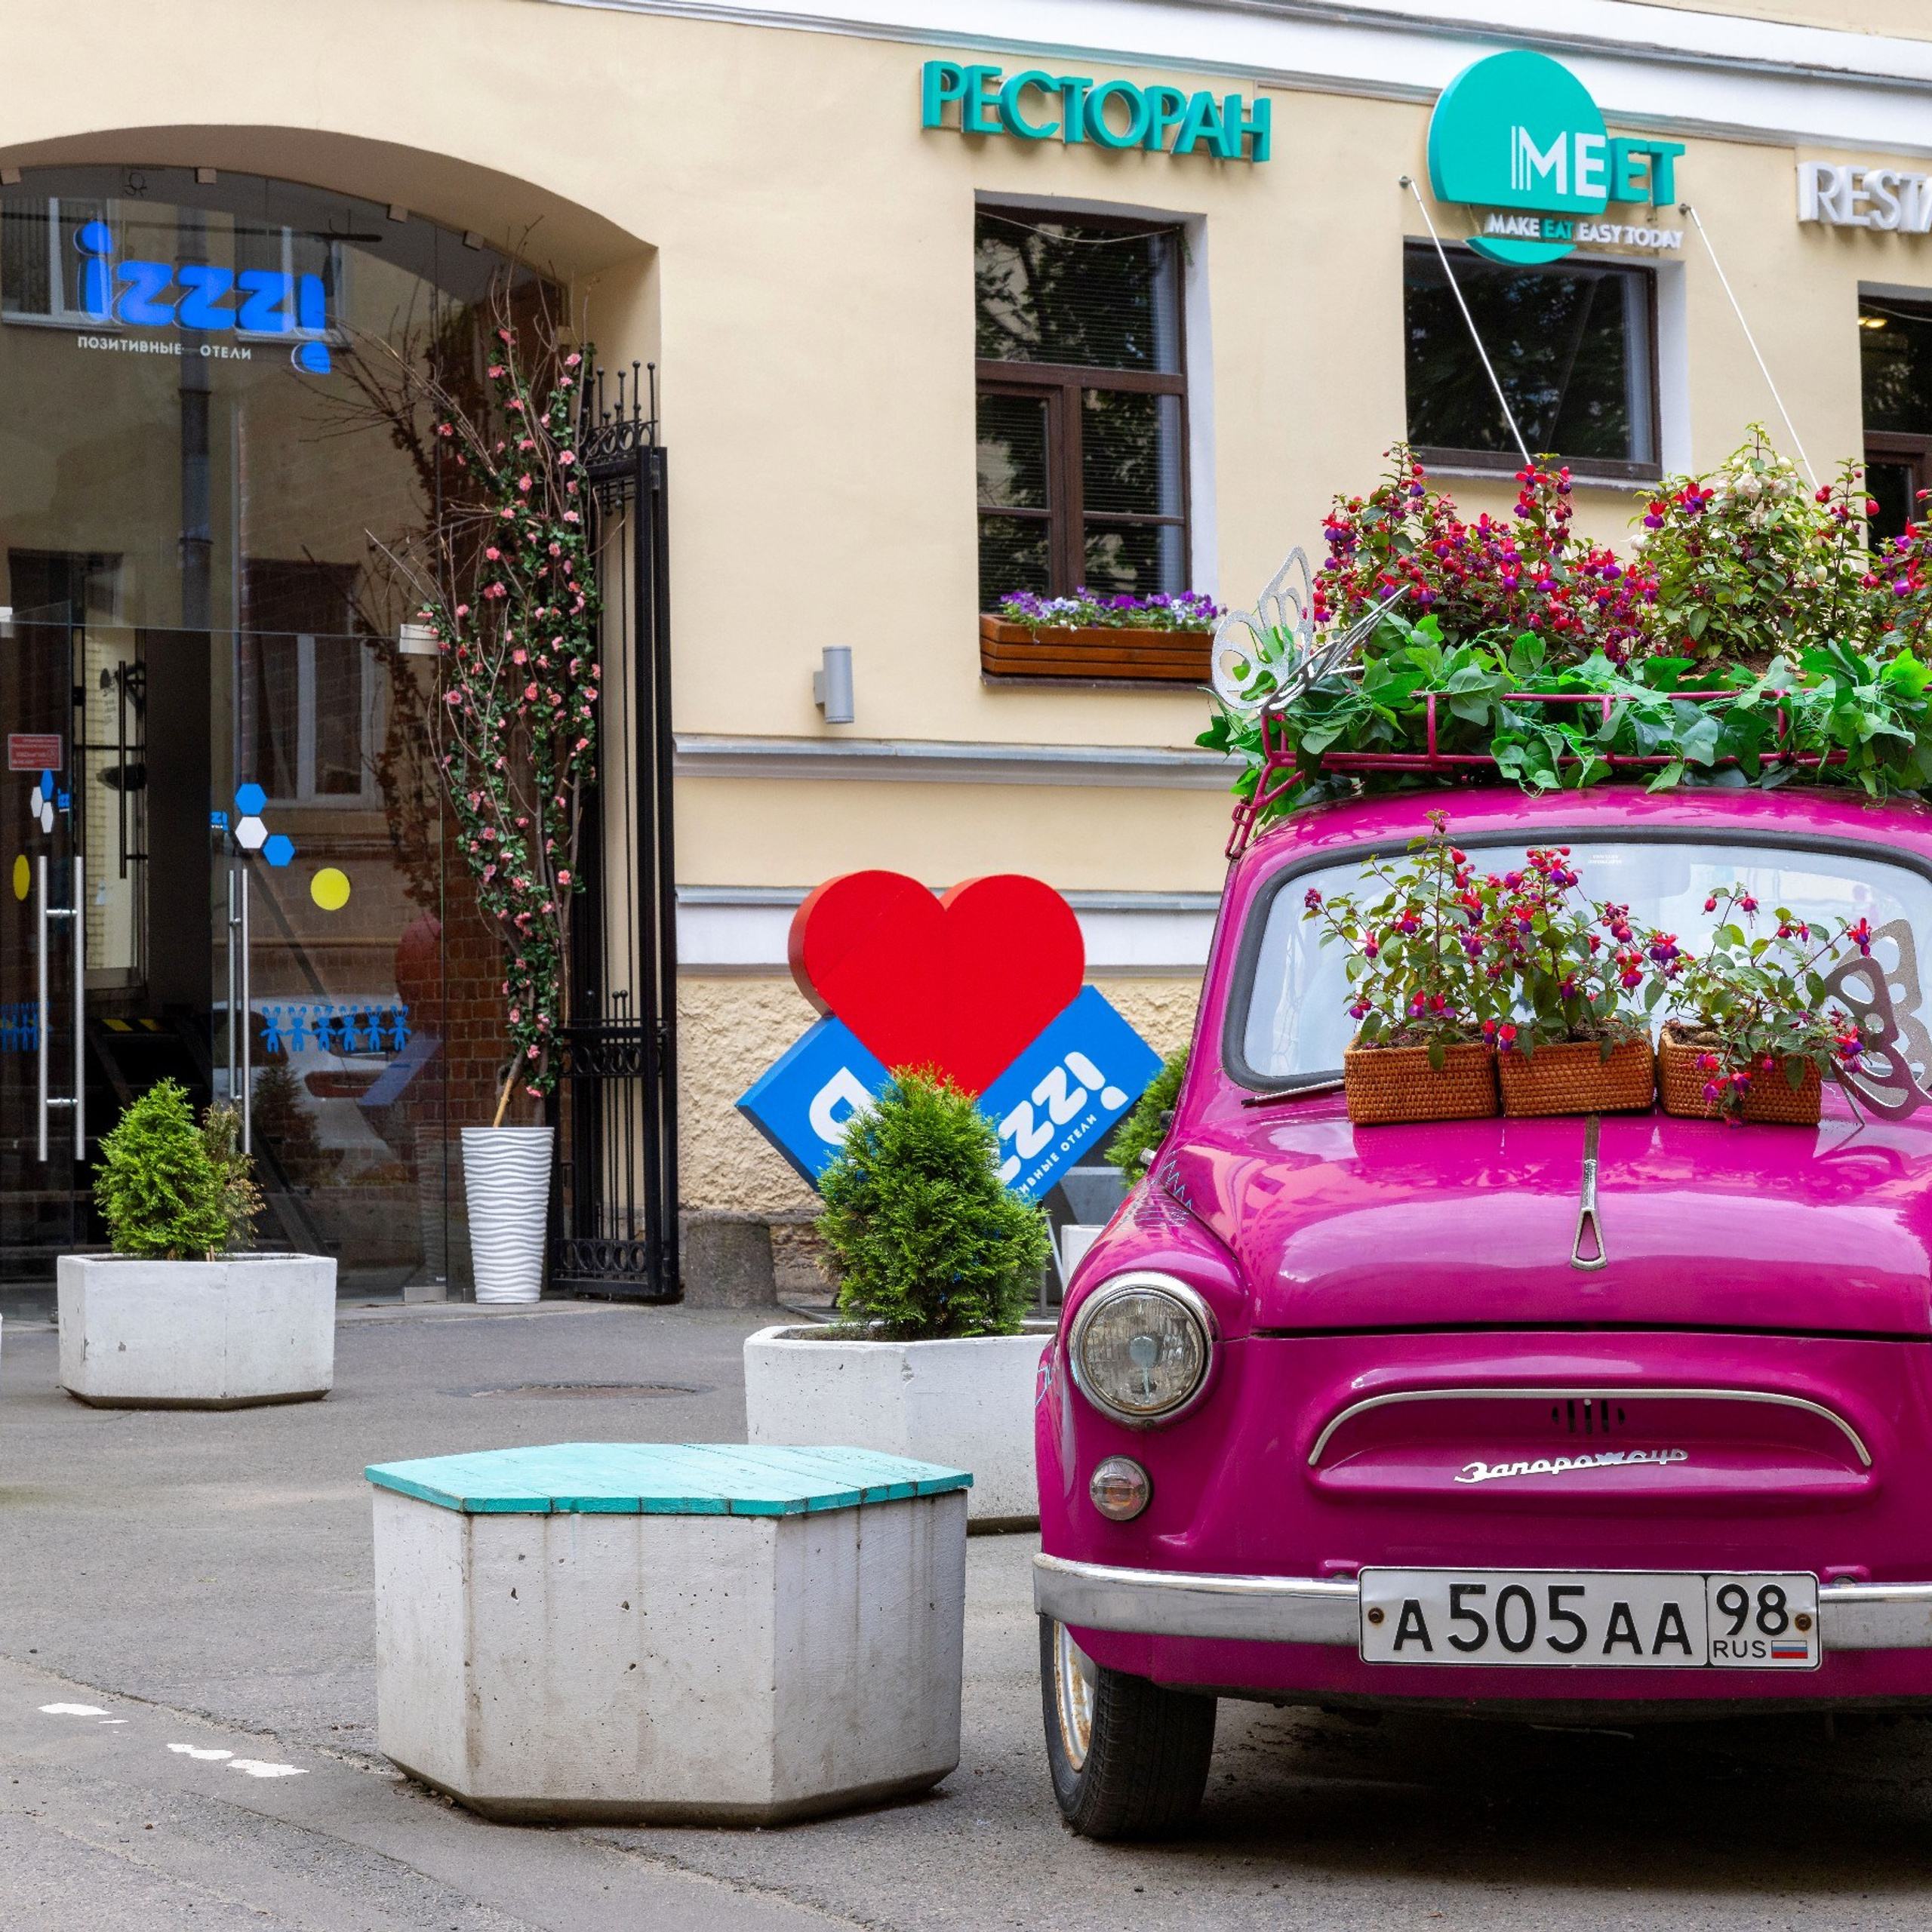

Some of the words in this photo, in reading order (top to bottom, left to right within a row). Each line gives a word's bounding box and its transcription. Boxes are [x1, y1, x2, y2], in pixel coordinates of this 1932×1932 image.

[921, 60, 1271, 162] РЕСТОРАН
[1511, 125, 1685, 207] MEET
[1484, 212, 1540, 238] MAKE
[1540, 219, 1574, 240] EAT
[1576, 223, 1622, 244] EASY
[1623, 226, 1684, 248] TODAY
[77, 336, 183, 355] ПОЗИТИВНЫЕ
[199, 344, 252, 360] ОТЕЛИ
[1017, 1152, 1060, 1195] ИВНЫЕ
[1060, 1114, 1097, 1152] ОТЕЛИ
[1715, 1583, 1789, 1637] 98
[1712, 1639, 1767, 1660] RUS
